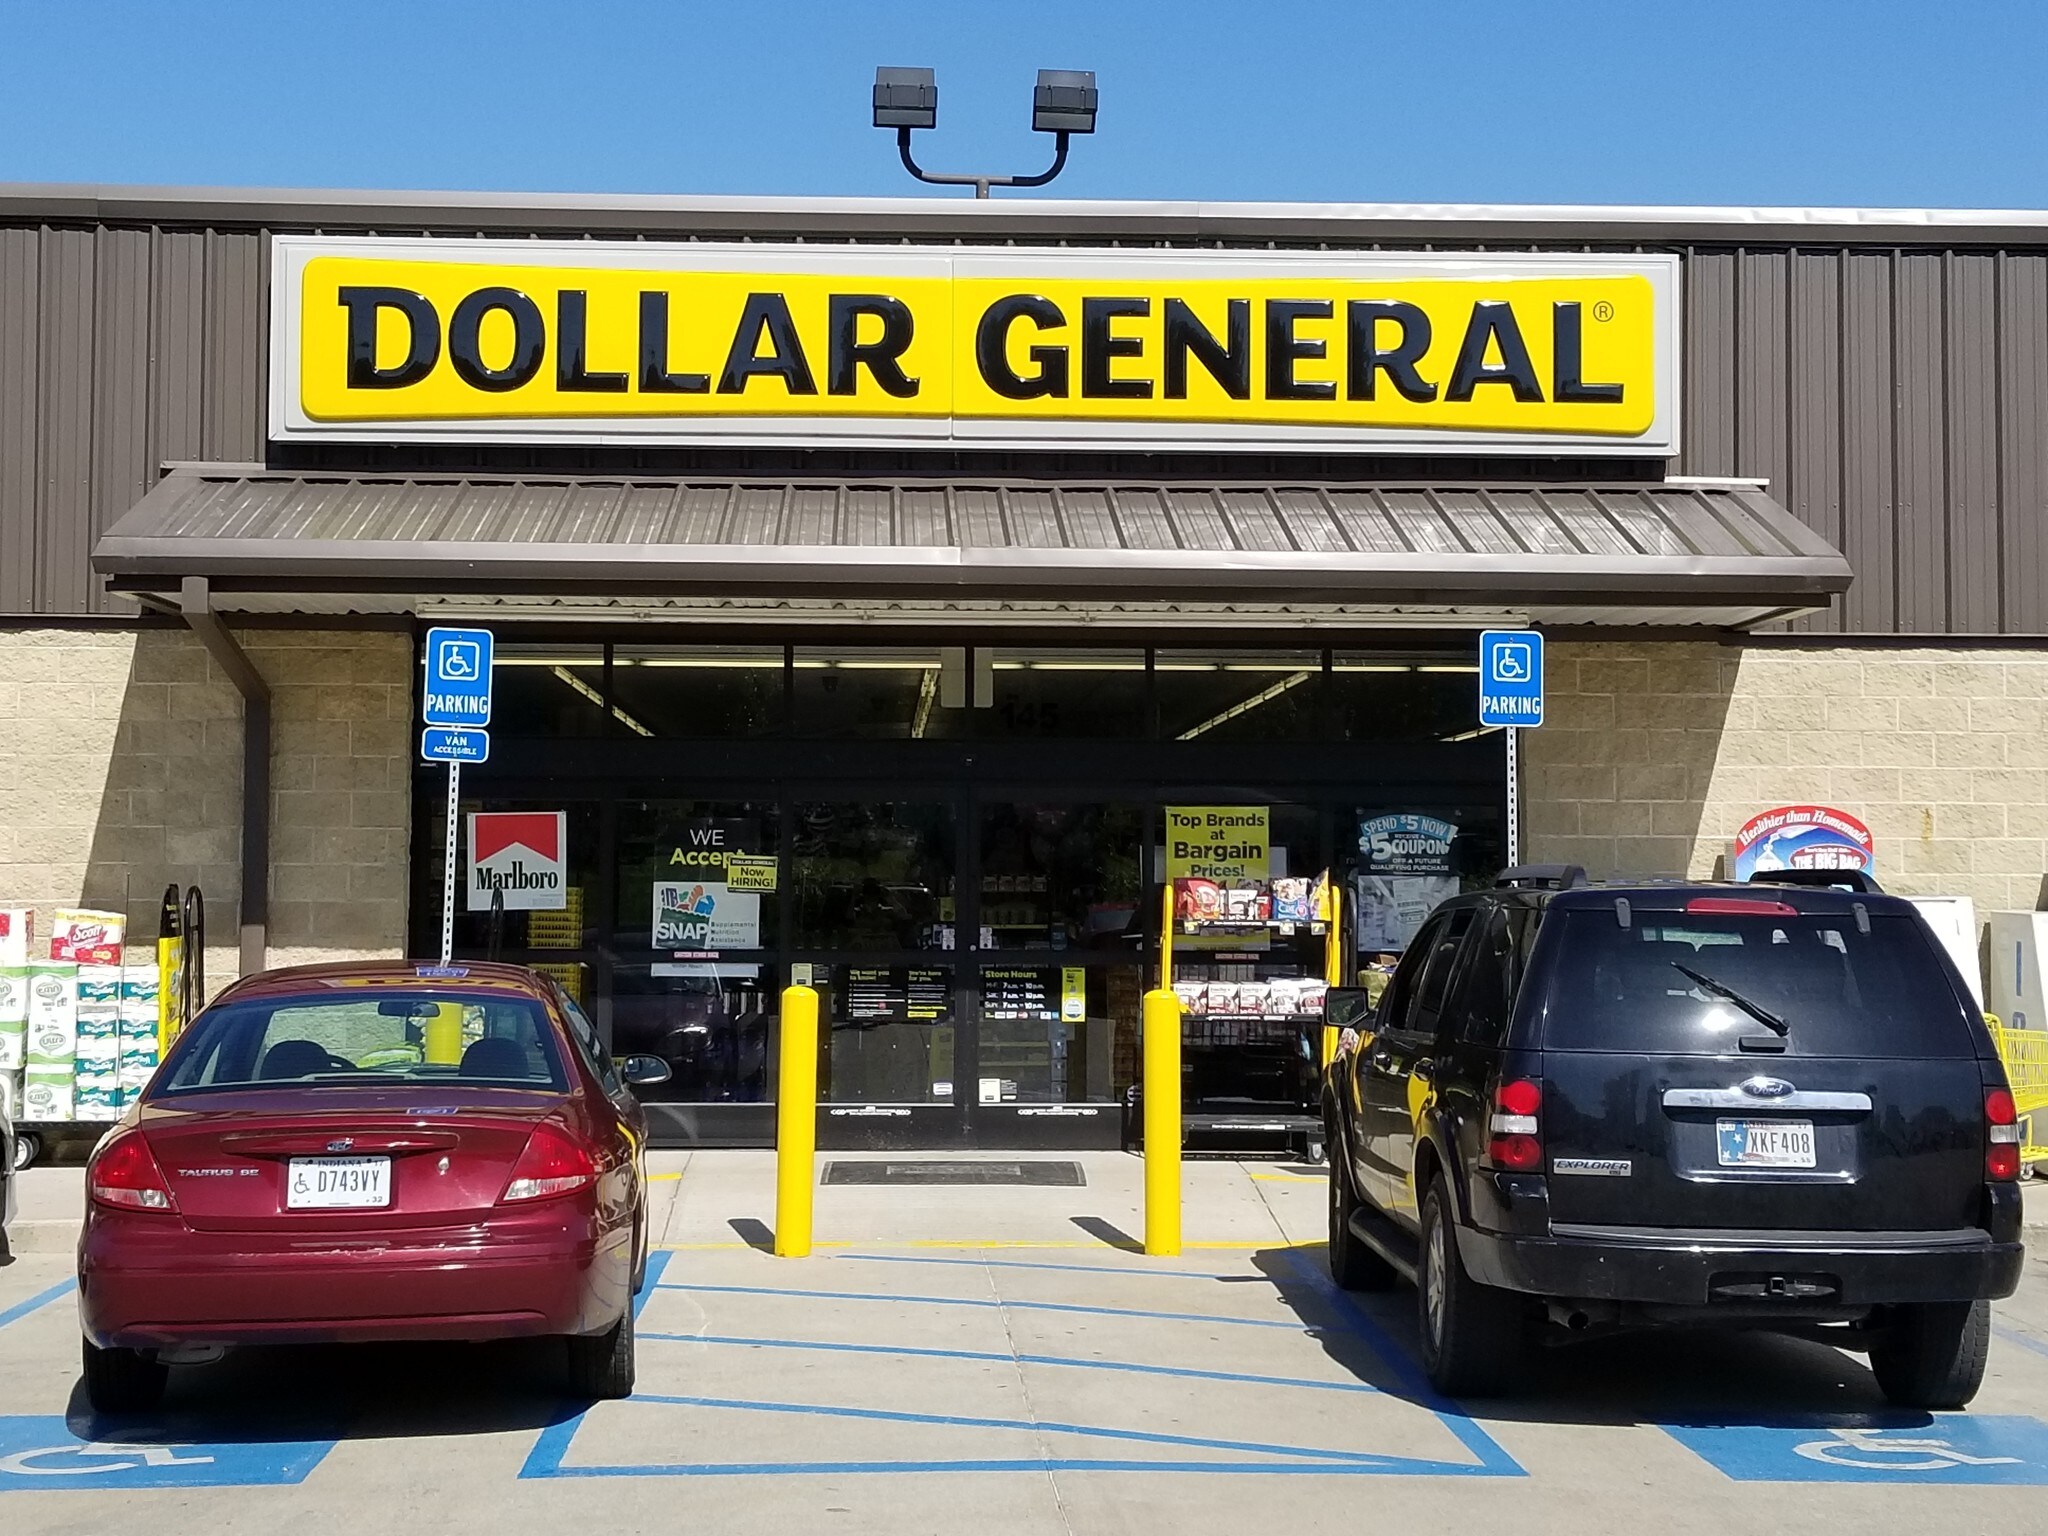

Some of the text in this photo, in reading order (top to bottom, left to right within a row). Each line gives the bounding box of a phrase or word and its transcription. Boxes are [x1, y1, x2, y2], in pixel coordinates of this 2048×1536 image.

[338, 286, 920, 399] DOLLAR
[975, 294, 1625, 404] GENERAL
[427, 694, 488, 714] PARKING
[1482, 696, 1541, 715] PARKING
[445, 735, 468, 746] VAN
[433, 746, 477, 755] ACCESSIBLE
[1171, 813, 1265, 829] Top Brands
[1363, 815, 1448, 837] SPEND $5 NOW
[1738, 809, 1869, 847] Healthier than Homemade
[689, 828, 725, 846] WE
[1210, 829, 1226, 841] at
[1174, 841, 1263, 862] Bargain
[1358, 832, 1393, 861] $5
[1369, 863, 1450, 872] QUALIFYING PURCHASE
[1794, 852, 1862, 869] THE BIG BAG
[476, 861, 559, 890] Marlboro
[740, 866, 766, 877] Now
[1190, 864, 1245, 878] Prices!
[730, 876, 774, 888] HIRING!
[73, 925, 103, 941] Scott
[657, 922, 708, 940] SNAP
[985, 970, 1038, 978] Store Hours
[1750, 1131, 1811, 1155] XKF408
[317, 1159, 362, 1168] INDIANA
[1556, 1160, 1630, 1171] EXPLORER
[177, 1168, 260, 1177] TAURUS SE
[317, 1169, 380, 1193] D743VY
